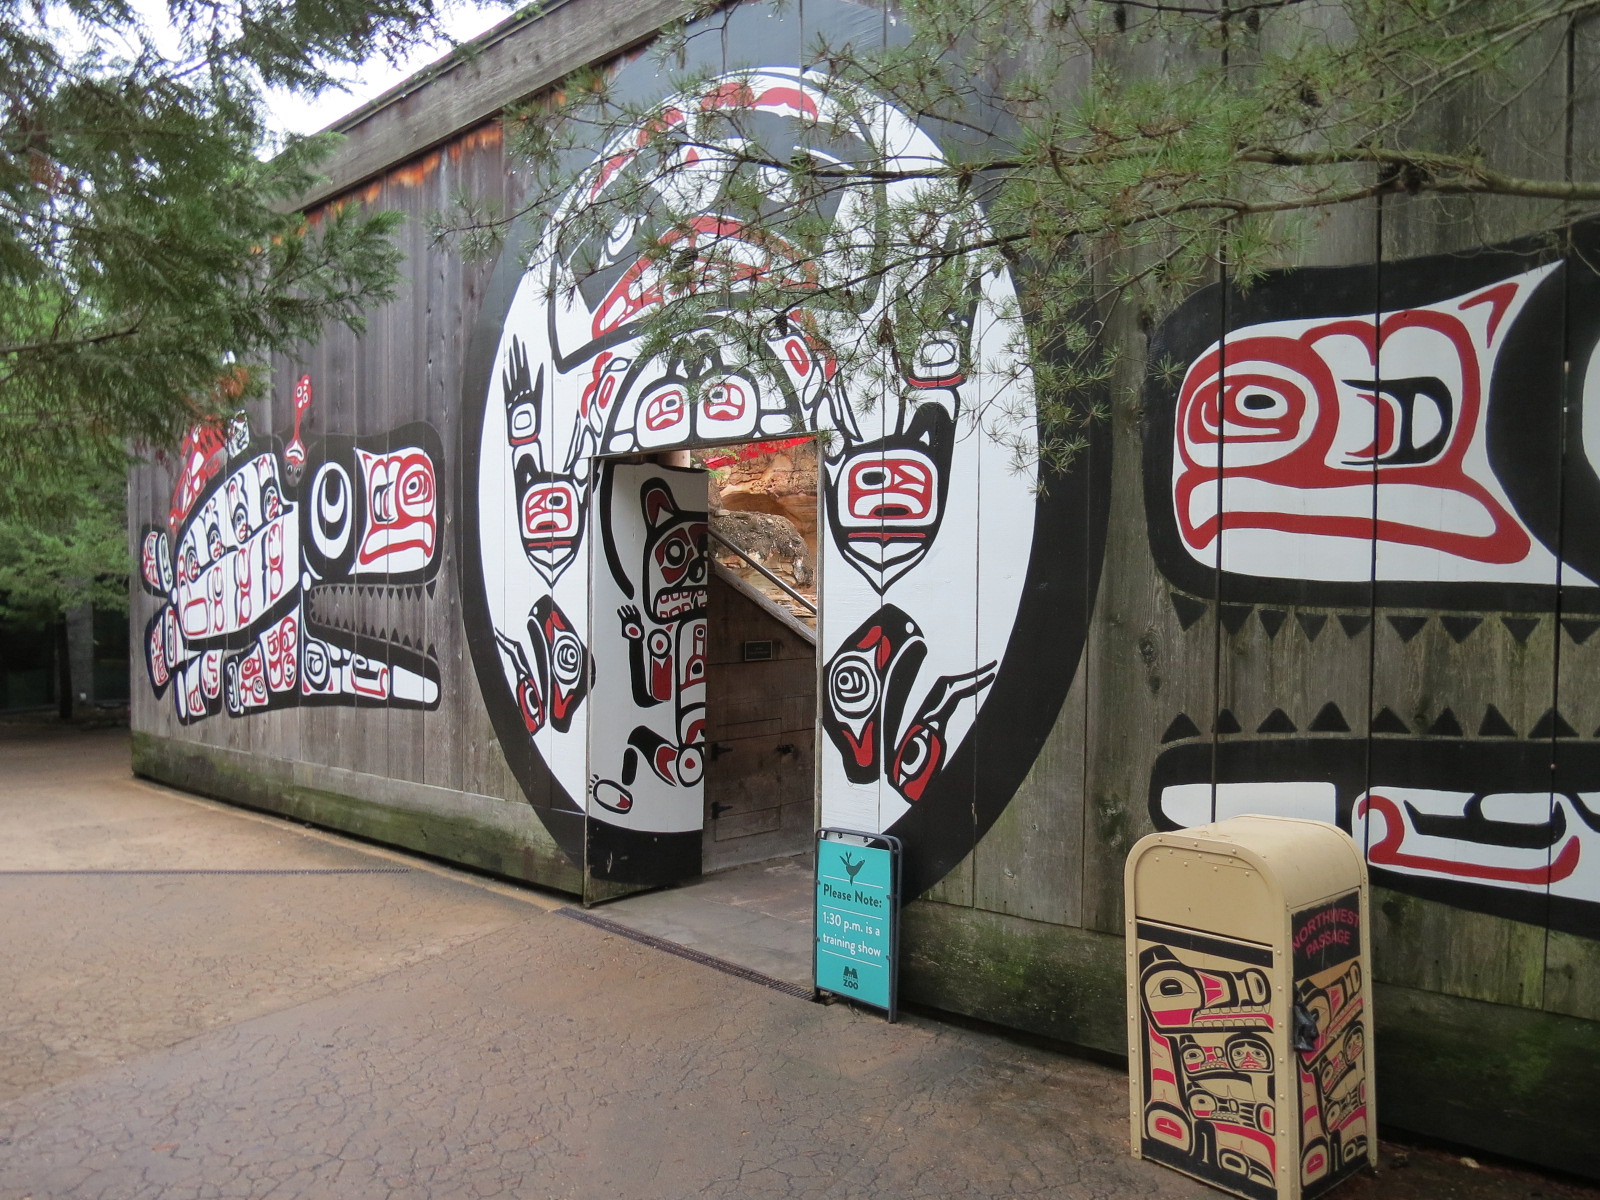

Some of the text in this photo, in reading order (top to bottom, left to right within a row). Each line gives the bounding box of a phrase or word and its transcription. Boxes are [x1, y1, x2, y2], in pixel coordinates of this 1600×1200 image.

[823, 883, 882, 908] Please Note:
[823, 911, 881, 936] 1:30 p.m. is a
[1293, 908, 1360, 953] NORTHWEST
[823, 933, 881, 957] training show
[1306, 929, 1351, 959] PASSAGE
